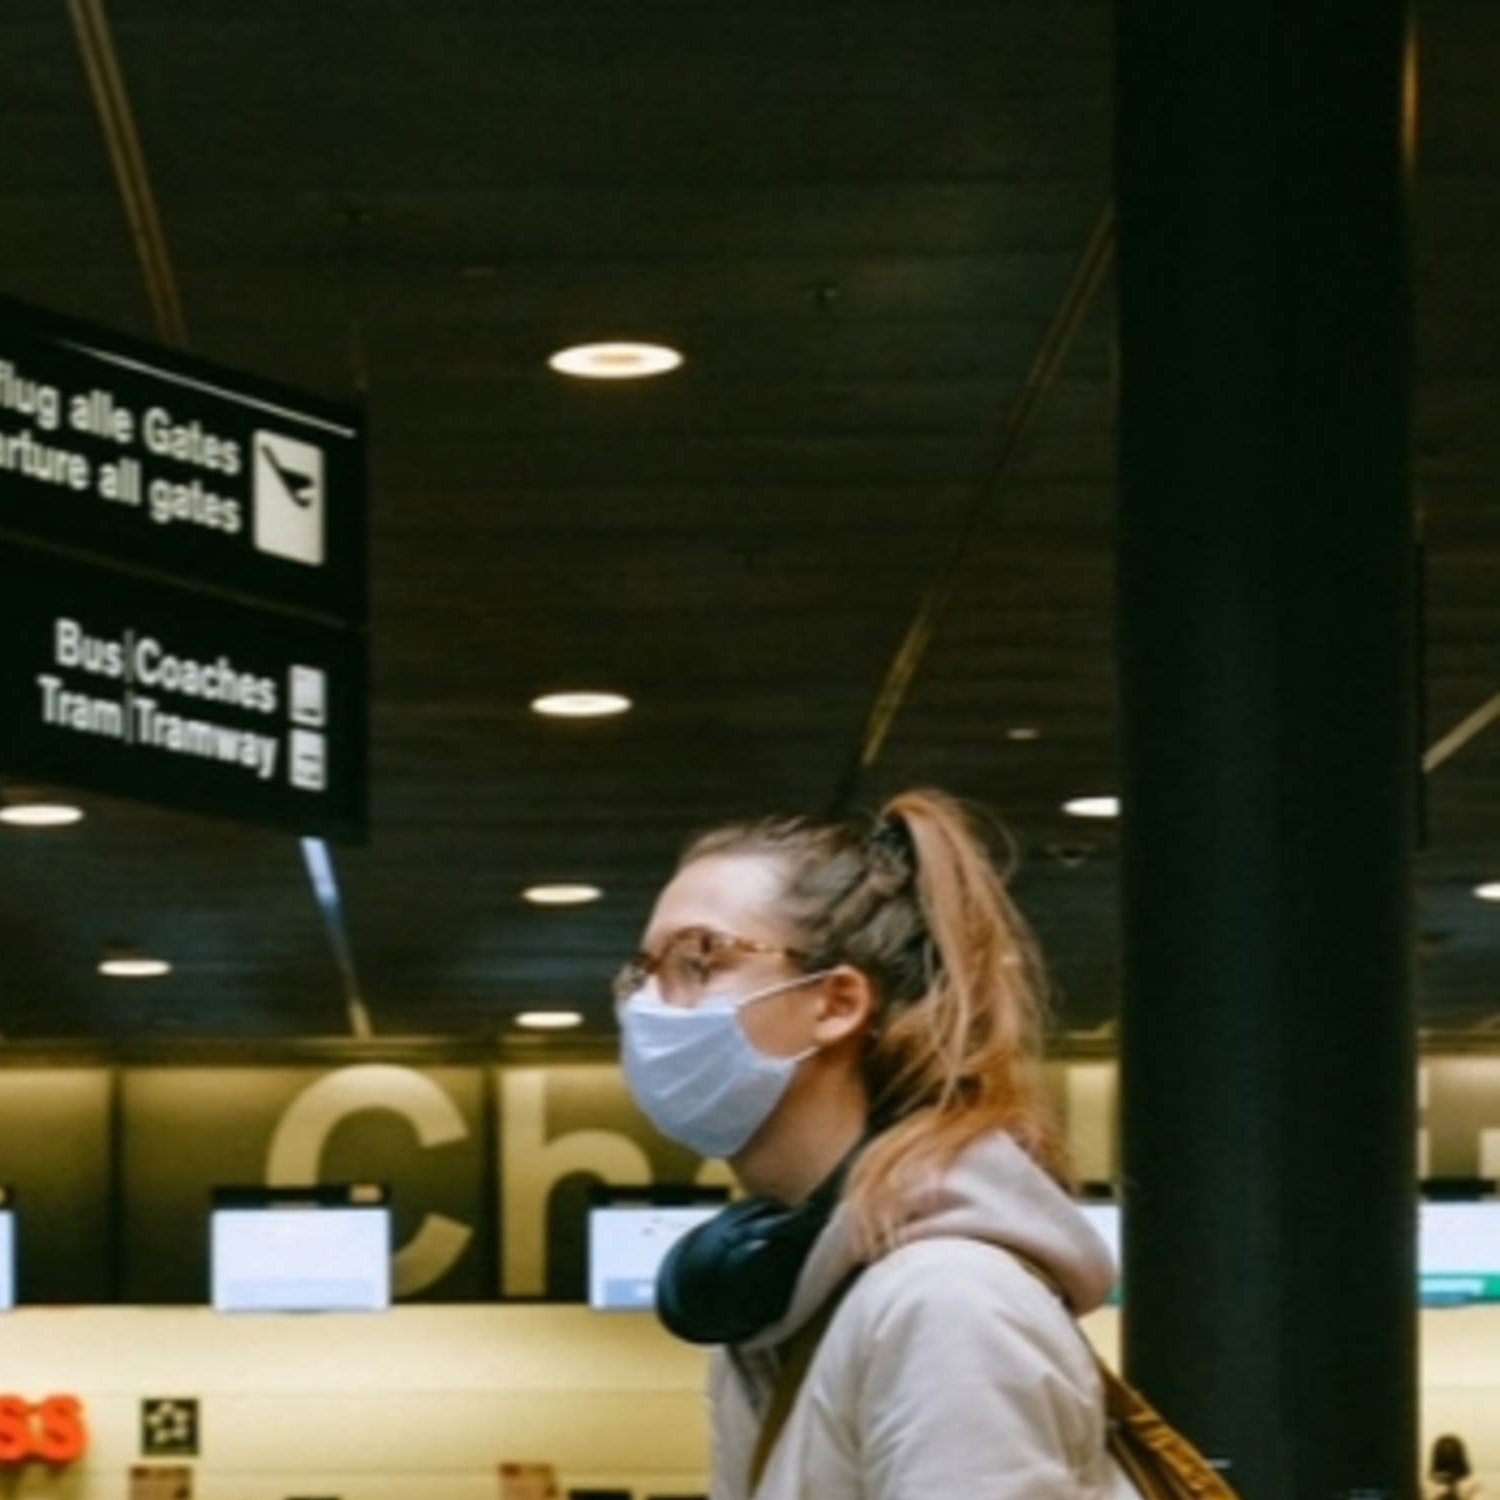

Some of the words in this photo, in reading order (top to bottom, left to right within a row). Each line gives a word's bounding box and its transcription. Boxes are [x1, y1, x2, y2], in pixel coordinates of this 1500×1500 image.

[69, 390, 134, 443] alle
[143, 407, 241, 475] Gates
[98, 458, 142, 505] all
[149, 479, 242, 533] gates
[266, 1064, 740, 1296] Ch
